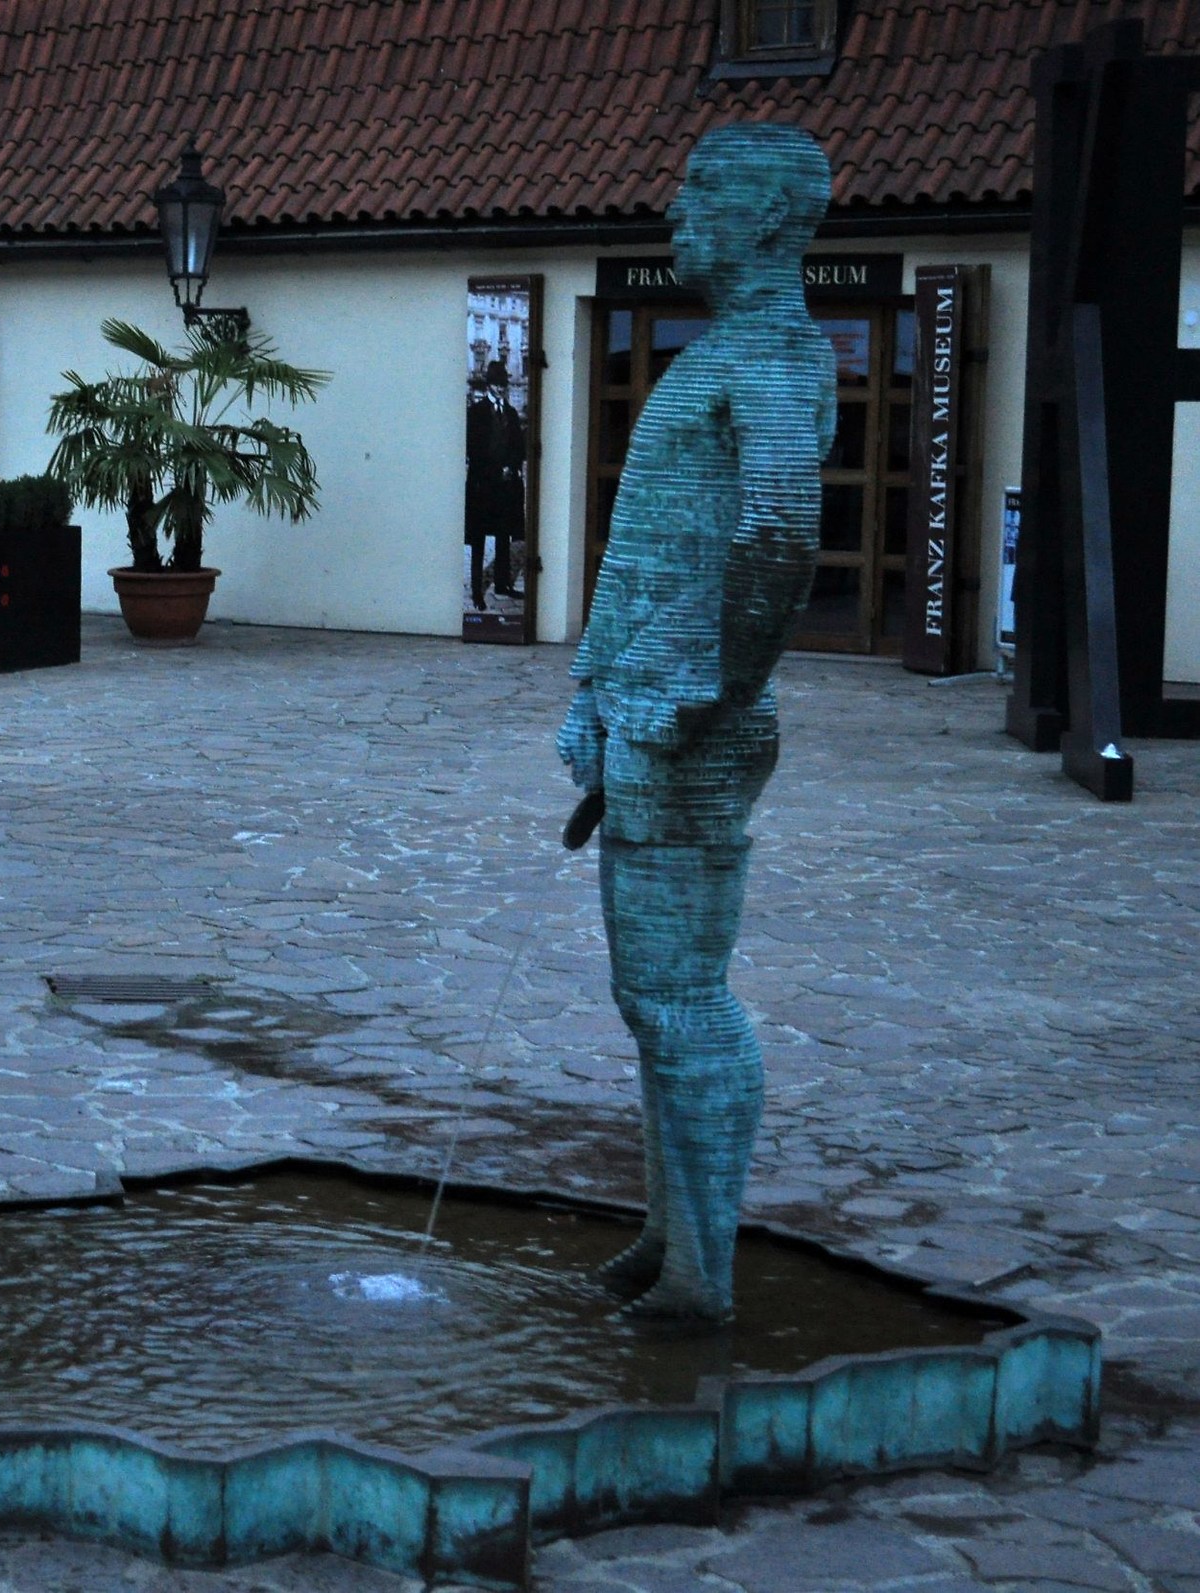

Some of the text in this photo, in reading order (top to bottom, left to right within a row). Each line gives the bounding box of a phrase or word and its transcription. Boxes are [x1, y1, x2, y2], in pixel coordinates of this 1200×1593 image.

[626, 265, 867, 286] FRAN SEUM
[932, 286, 954, 422] MUSEUM
[929, 432, 949, 530] KAFKA
[926, 539, 945, 637] FRANZ
